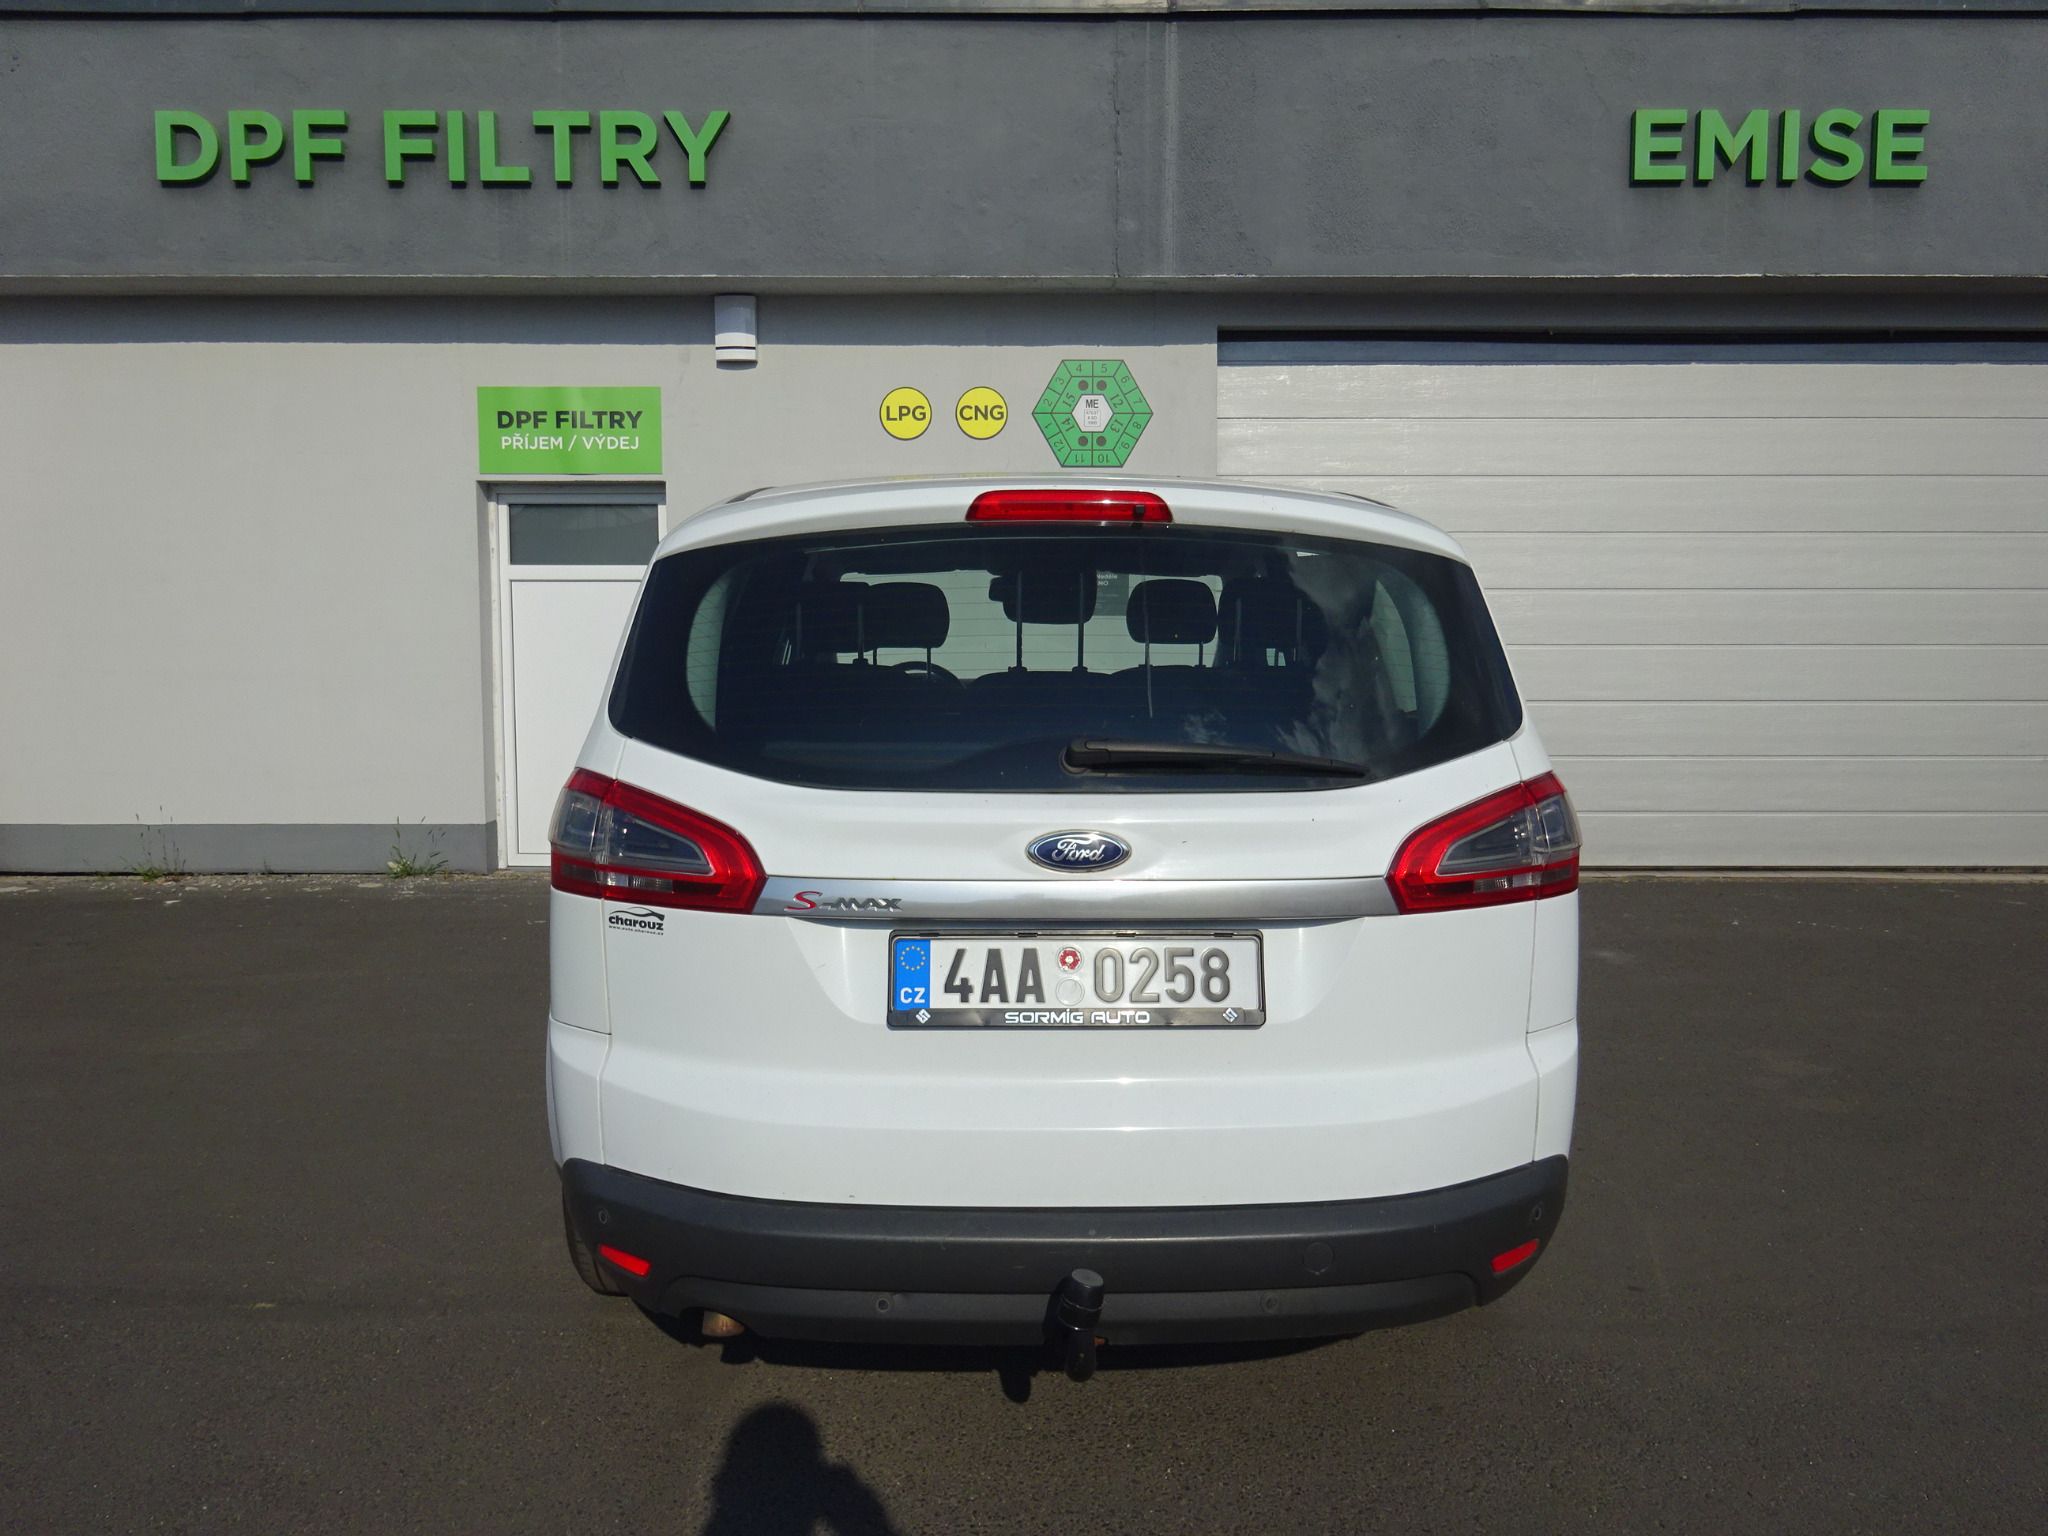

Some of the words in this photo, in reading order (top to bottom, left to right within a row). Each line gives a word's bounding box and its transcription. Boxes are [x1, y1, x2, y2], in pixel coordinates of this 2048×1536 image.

[154, 109, 347, 183] DPF
[383, 109, 732, 184] FILTRY
[1631, 107, 1931, 184] EMISE
[1075, 364, 1083, 373] 4
[1100, 363, 1108, 374] 5
[1055, 377, 1065, 385] 3
[1120, 375, 1130, 384] 6
[1043, 398, 1053, 407] 2
[1062, 392, 1076, 408] 15
[1085, 398, 1099, 409] ME
[1109, 394, 1124, 409] 12
[497, 411, 548, 429] DPF
[555, 411, 643, 429] FILTRY
[886, 405, 927, 421] LPG
[959, 404, 1005, 421] CNG
[1061, 417, 1076, 432] 14
[1109, 419, 1124, 433] 13
[1132, 421, 1142, 430] 8
[501, 433, 563, 450] PŘÍJEM
[582, 433, 640, 450] VÝDEJ
[1053, 440, 1065, 452] 12
[1120, 441, 1130, 450] 9
[1074, 454, 1084, 463] 11
[1097, 454, 1109, 463] 10
[1051, 837, 1106, 861] Ford
[784, 890, 903, 912] S-MAX
[608, 914, 664, 931] charouz
[944, 948, 1046, 1003] 4AA
[1094, 947, 1231, 1003] 0258
[900, 986, 926, 1004] CZ
[1091, 1010, 1150, 1024] AUTO
